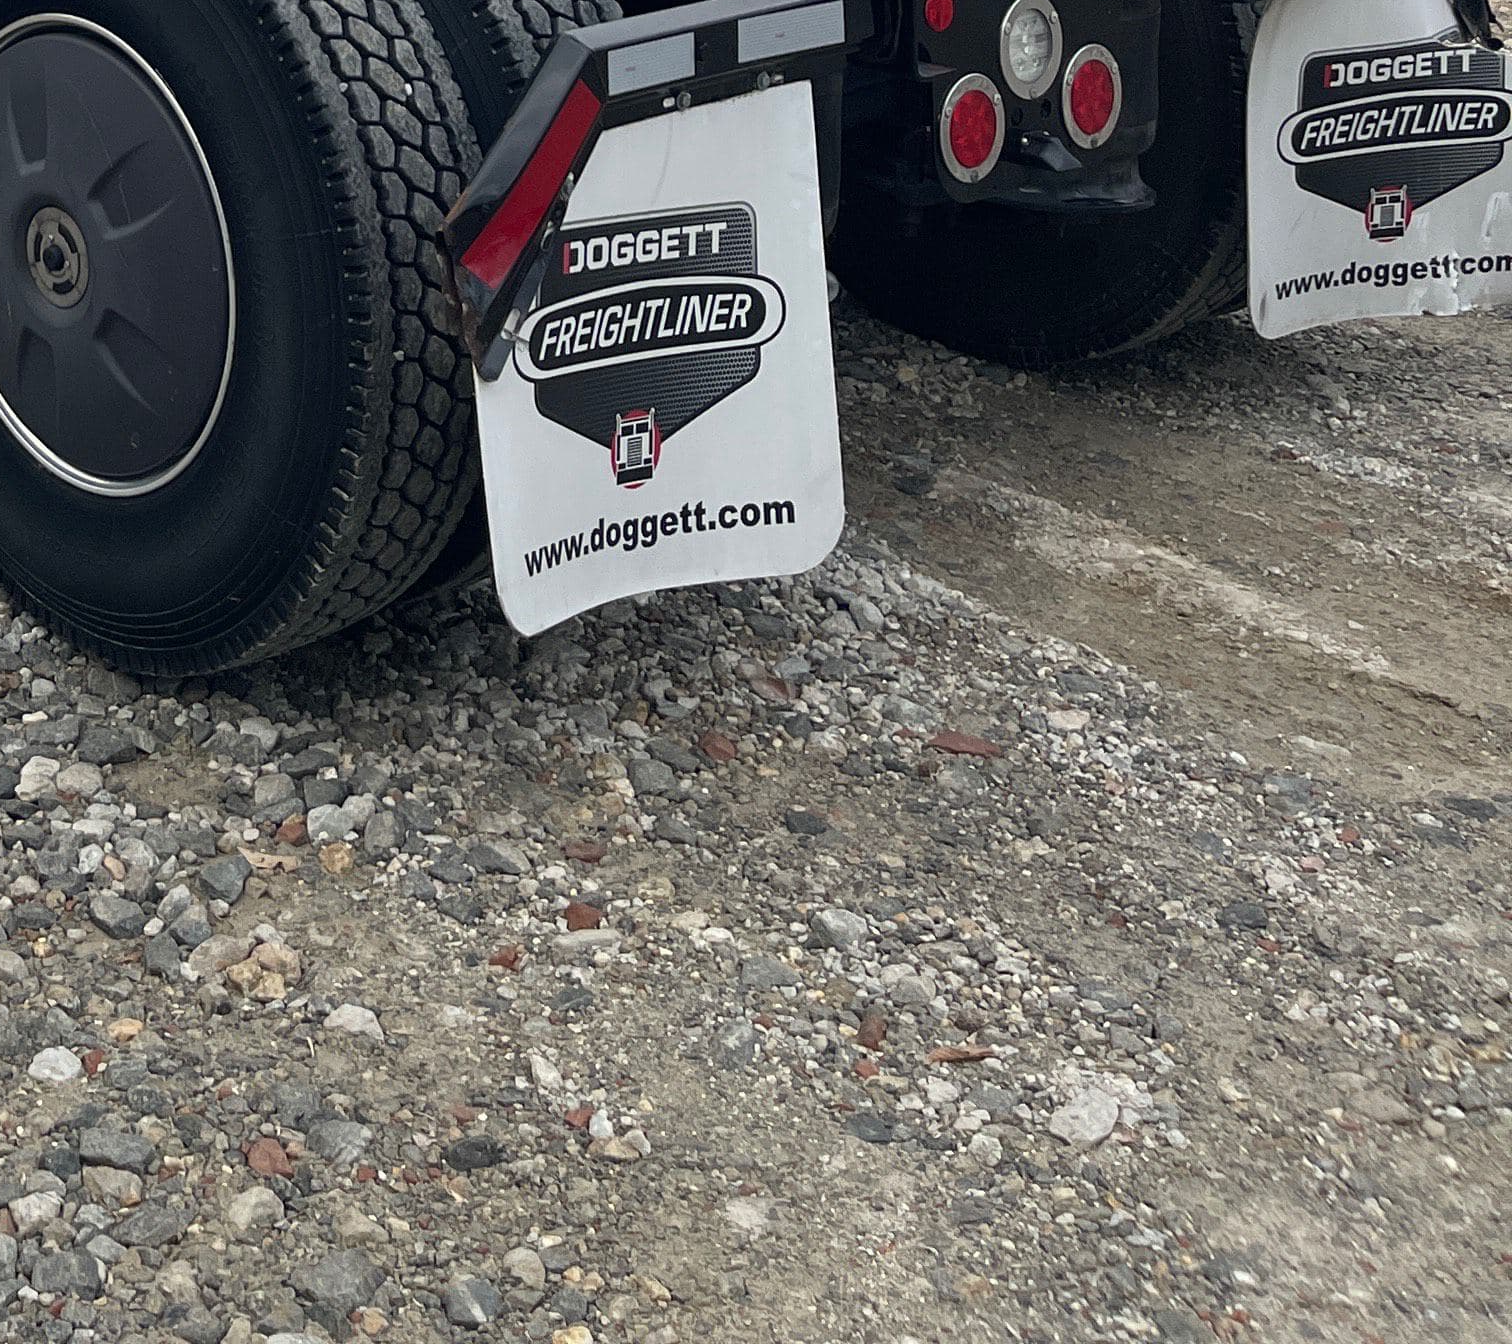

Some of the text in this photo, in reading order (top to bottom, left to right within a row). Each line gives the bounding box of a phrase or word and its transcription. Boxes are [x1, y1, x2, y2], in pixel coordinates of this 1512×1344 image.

[1323, 48, 1477, 89] DOGGETT
[1300, 102, 1499, 151] FREIGHTLINER
[563, 222, 728, 275] DOGGETT
[1274, 254, 1512, 301] www.doggettcom
[538, 293, 753, 362] FREIGHTLINER
[523, 499, 796, 578] www.doggett.com
